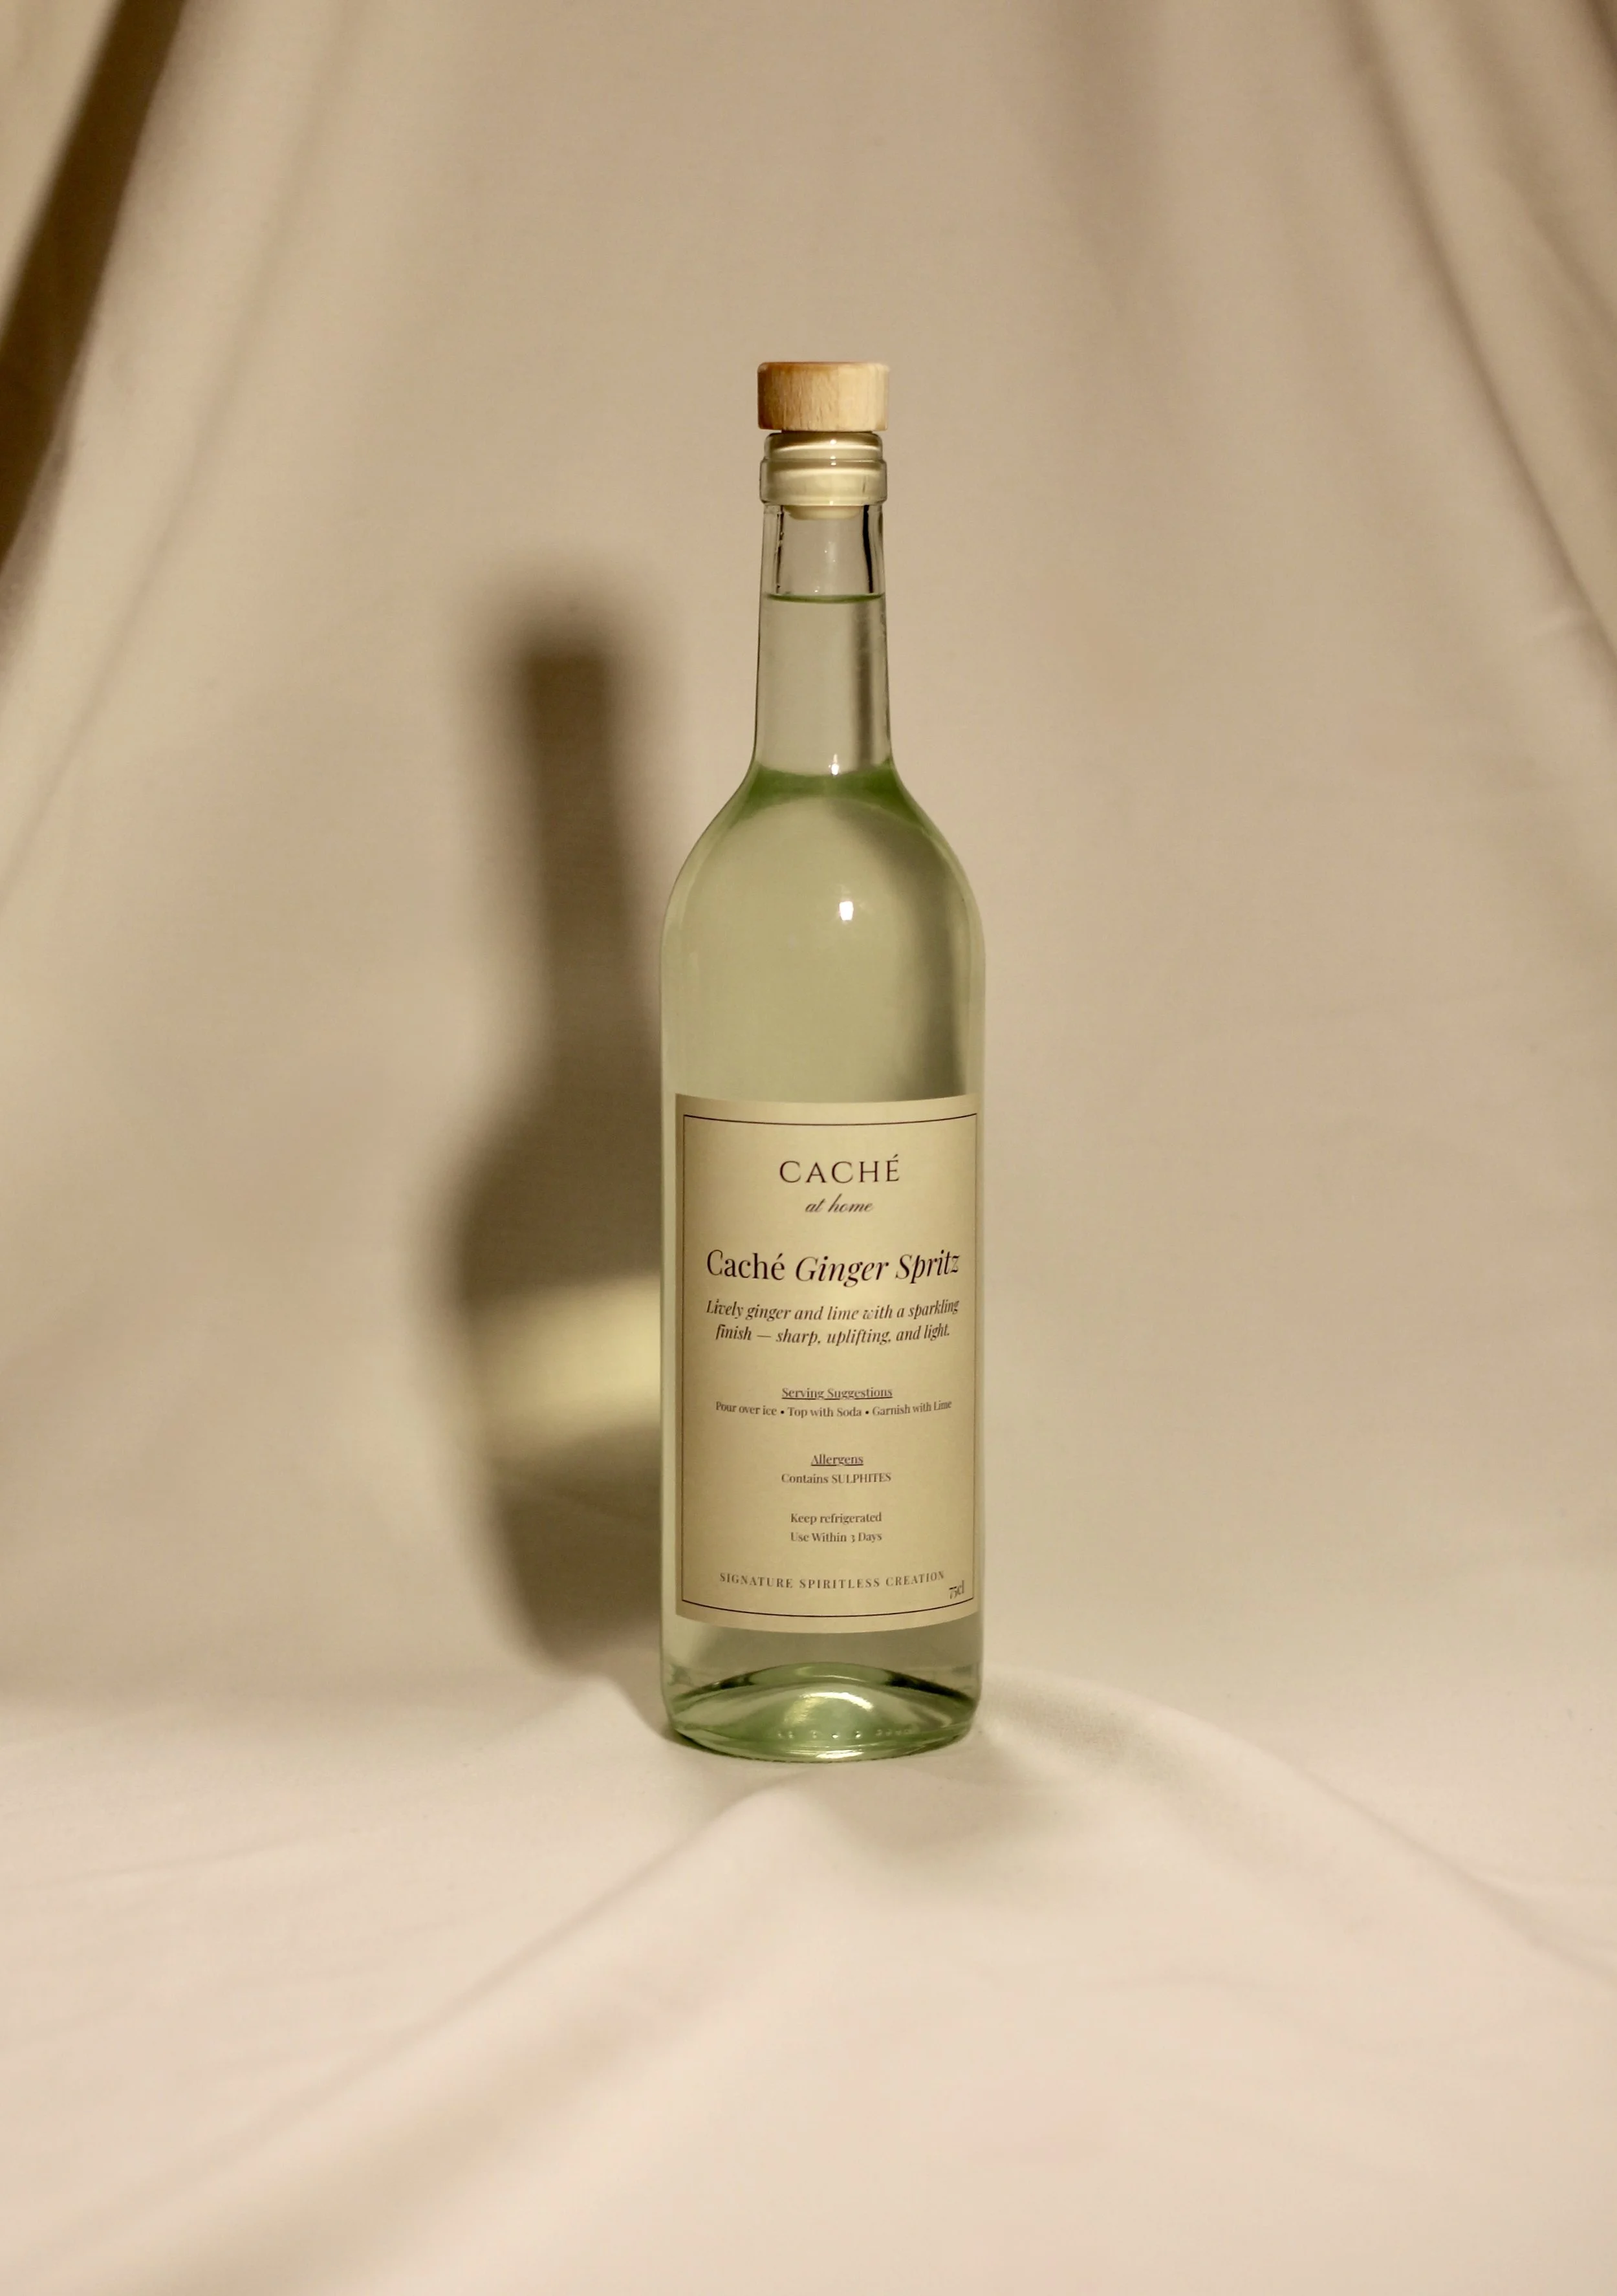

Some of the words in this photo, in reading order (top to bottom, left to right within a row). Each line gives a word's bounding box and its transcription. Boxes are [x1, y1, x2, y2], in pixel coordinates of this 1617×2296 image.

[779, 1153, 900, 1184] CACHÉ
[804, 1198, 823, 1213] at
[827, 1193, 873, 1213] home
[706, 1249, 785, 1281] Caché
[795, 1255, 889, 1288] Ginger
[895, 1249, 960, 1284] Spritz
[706, 1298, 744, 1319] Lively
[745, 1304, 792, 1322] ginger
[794, 1305, 824, 1321] and
[827, 1306, 860, 1321] lime
[862, 1304, 893, 1320] with
[896, 1307, 906, 1319] a
[907, 1299, 960, 1320] sparkling
[715, 1323, 752, 1341] finish
[776, 1328, 821, 1347] sharp,
[827, 1328, 891, 1347] uplifting,
[895, 1325, 922, 1342] and
[923, 1322, 950, 1341] light.
[781, 1387, 825, 1400] Serving
[827, 1387, 893, 1400] Suggestions
[715, 1401, 737, 1413] Pour
[738, 1405, 761, 1415] over
[762, 1405, 777, 1416] ice
[787, 1406, 808, 1419] Top
[809, 1407, 834, 1418] with
[836, 1406, 862, 1418] Soda
[871, 1403, 911, 1416] Garnish
[912, 1402, 932, 1413] with
[933, 1400, 953, 1411] Lime
[810, 1453, 864, 1467] Allergens
[781, 1473, 829, 1484] Contains
[831, 1472, 892, 1484] SULPHITES
[790, 1513, 818, 1526] Keep
[819, 1511, 882, 1526] refrigerated
[790, 1532, 810, 1543] Use
[811, 1532, 847, 1543] Within
[850, 1534, 856, 1544] 3
[858, 1532, 882, 1543] Days
[719, 1572, 794, 1589] SIGNATURE
[799, 1577, 880, 1589] SPIRITLESS
[885, 1570, 944, 1587] CREATION
